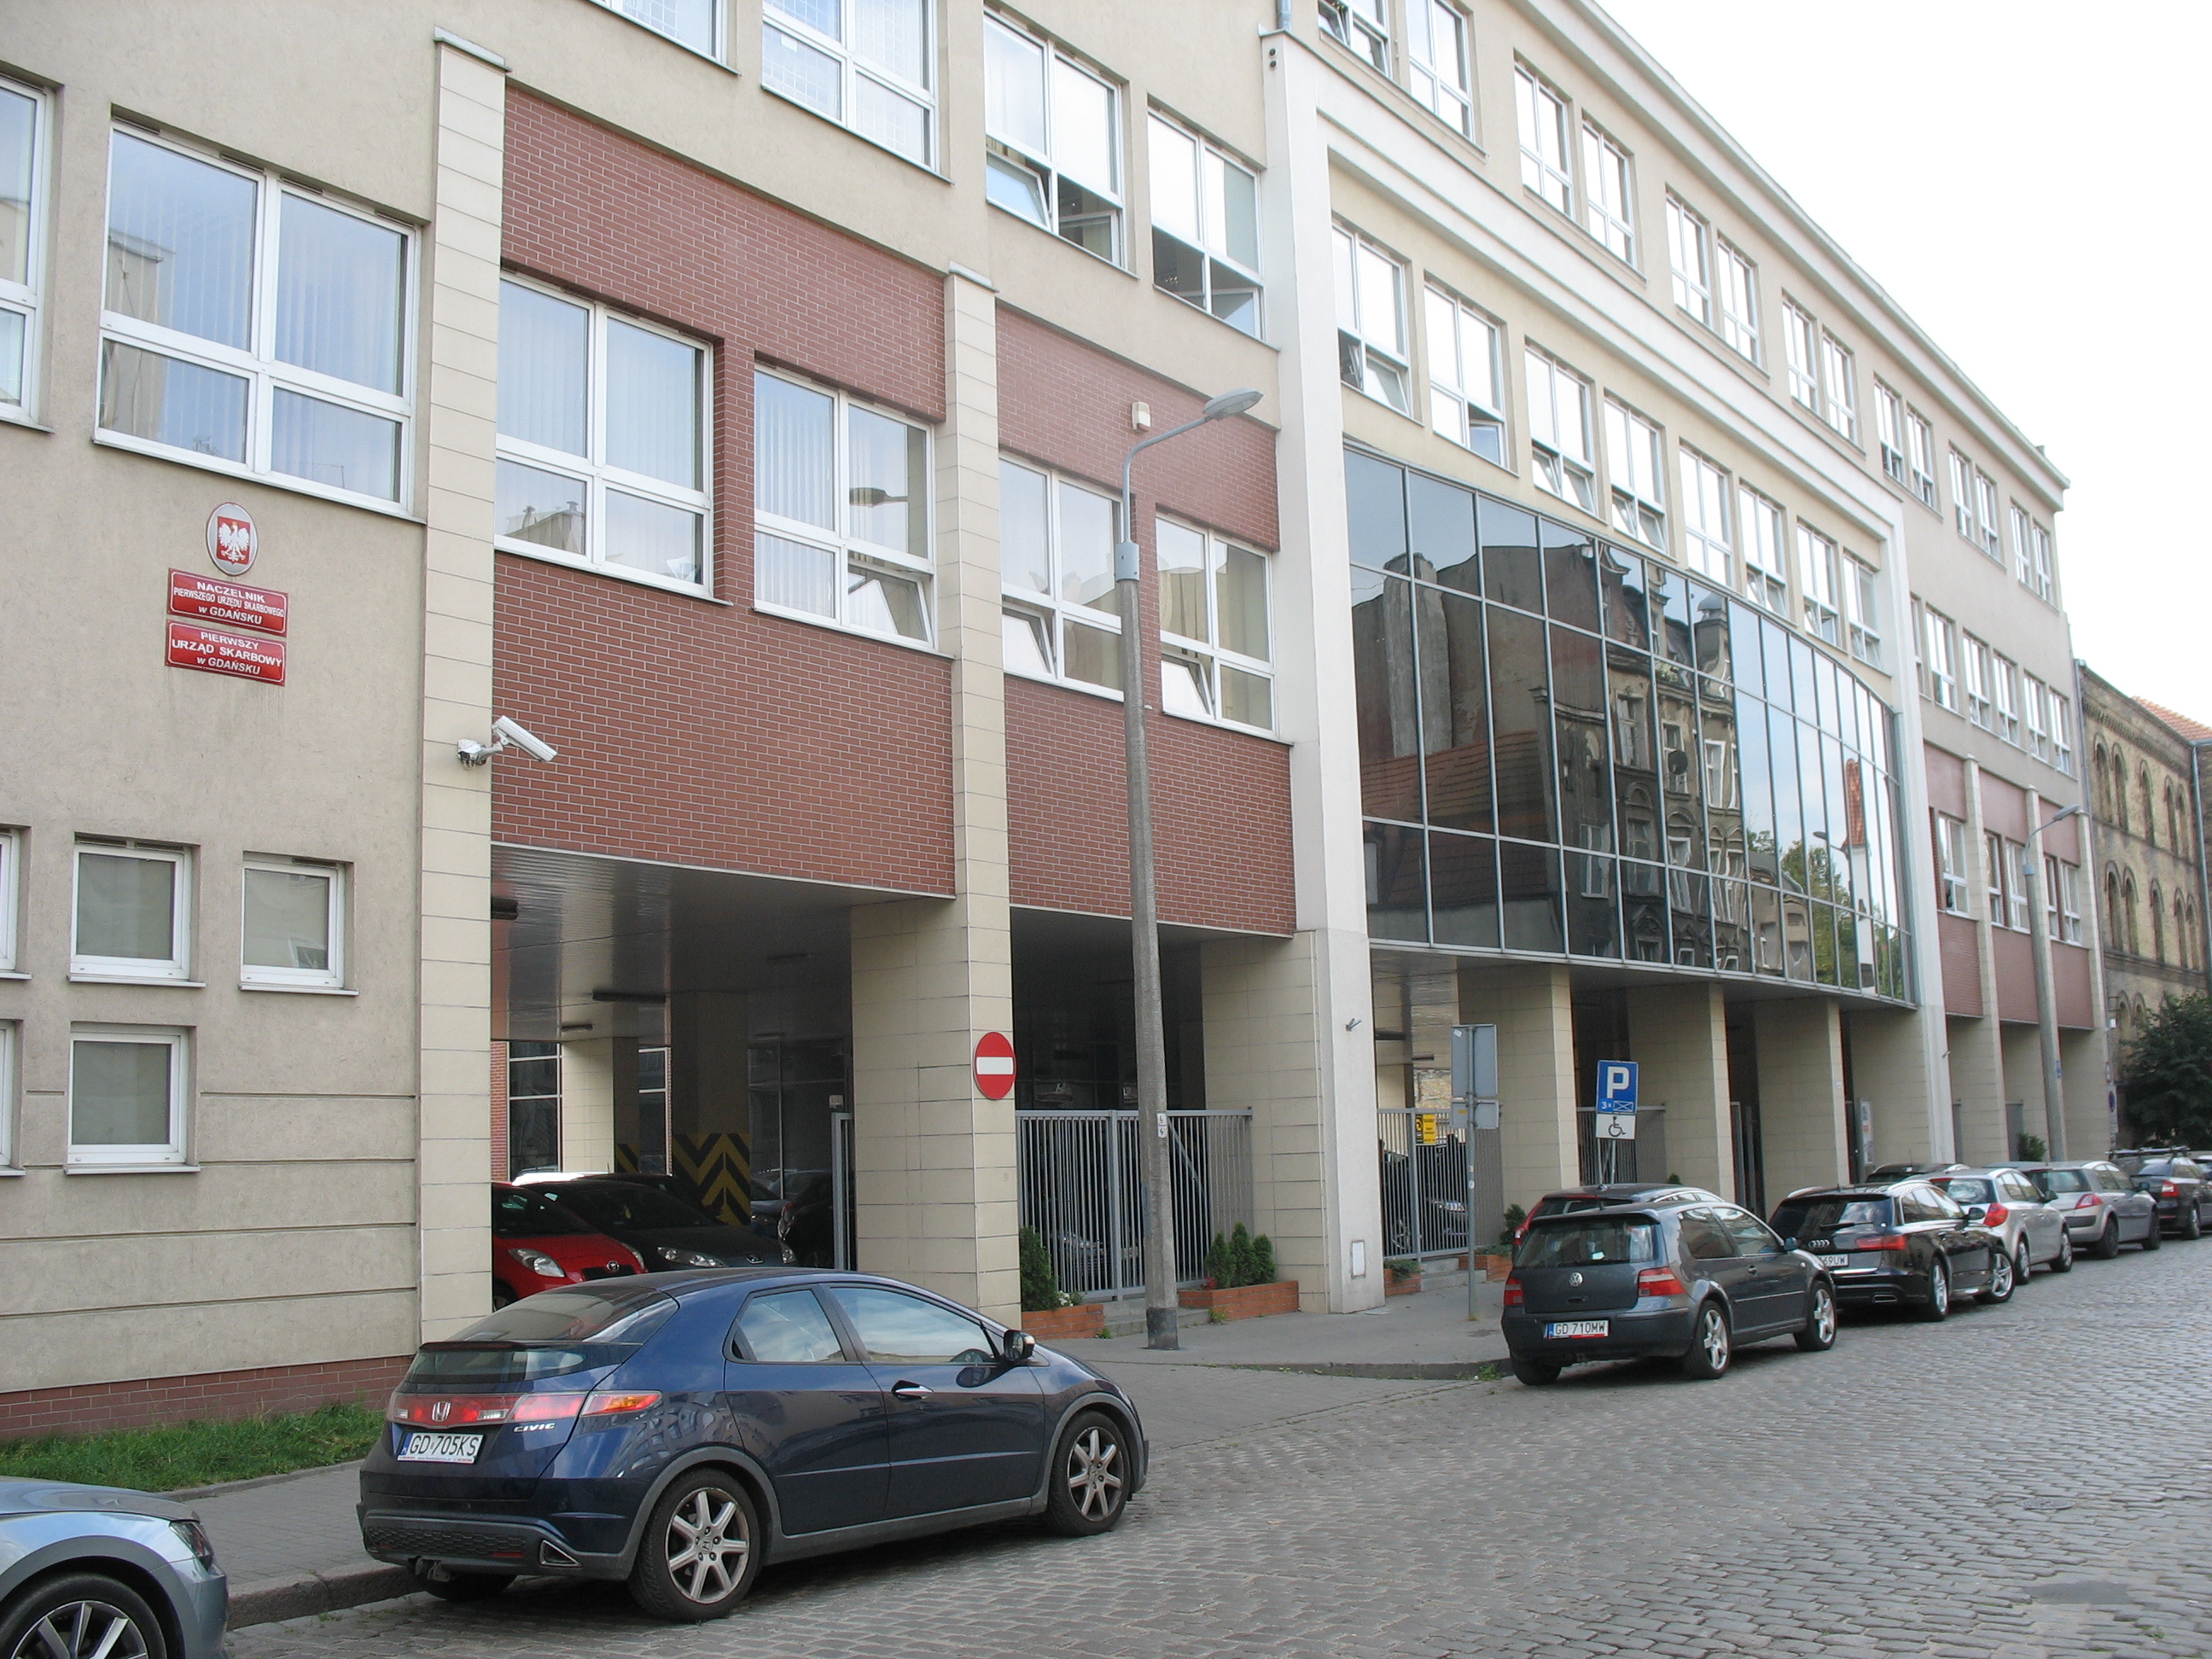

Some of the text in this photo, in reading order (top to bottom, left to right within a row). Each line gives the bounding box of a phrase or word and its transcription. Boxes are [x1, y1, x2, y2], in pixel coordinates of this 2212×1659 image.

[173, 586, 285, 618] PIERWSZEGO URZĘDU SKARBOWEGO
[196, 581, 265, 603] NACZELNIK
[209, 606, 262, 625] GDAŃSKU
[201, 632, 259, 650] PIERWSZY
[172, 639, 282, 667] URZĄD SKARBOWY
[207, 657, 260, 675] GDAŃSKU
[1606, 1066, 1629, 1099] P
[1555, 1323, 1569, 1335] GD
[513, 1423, 556, 1433] CIVIC
[410, 1435, 480, 1457] GD 705KS
